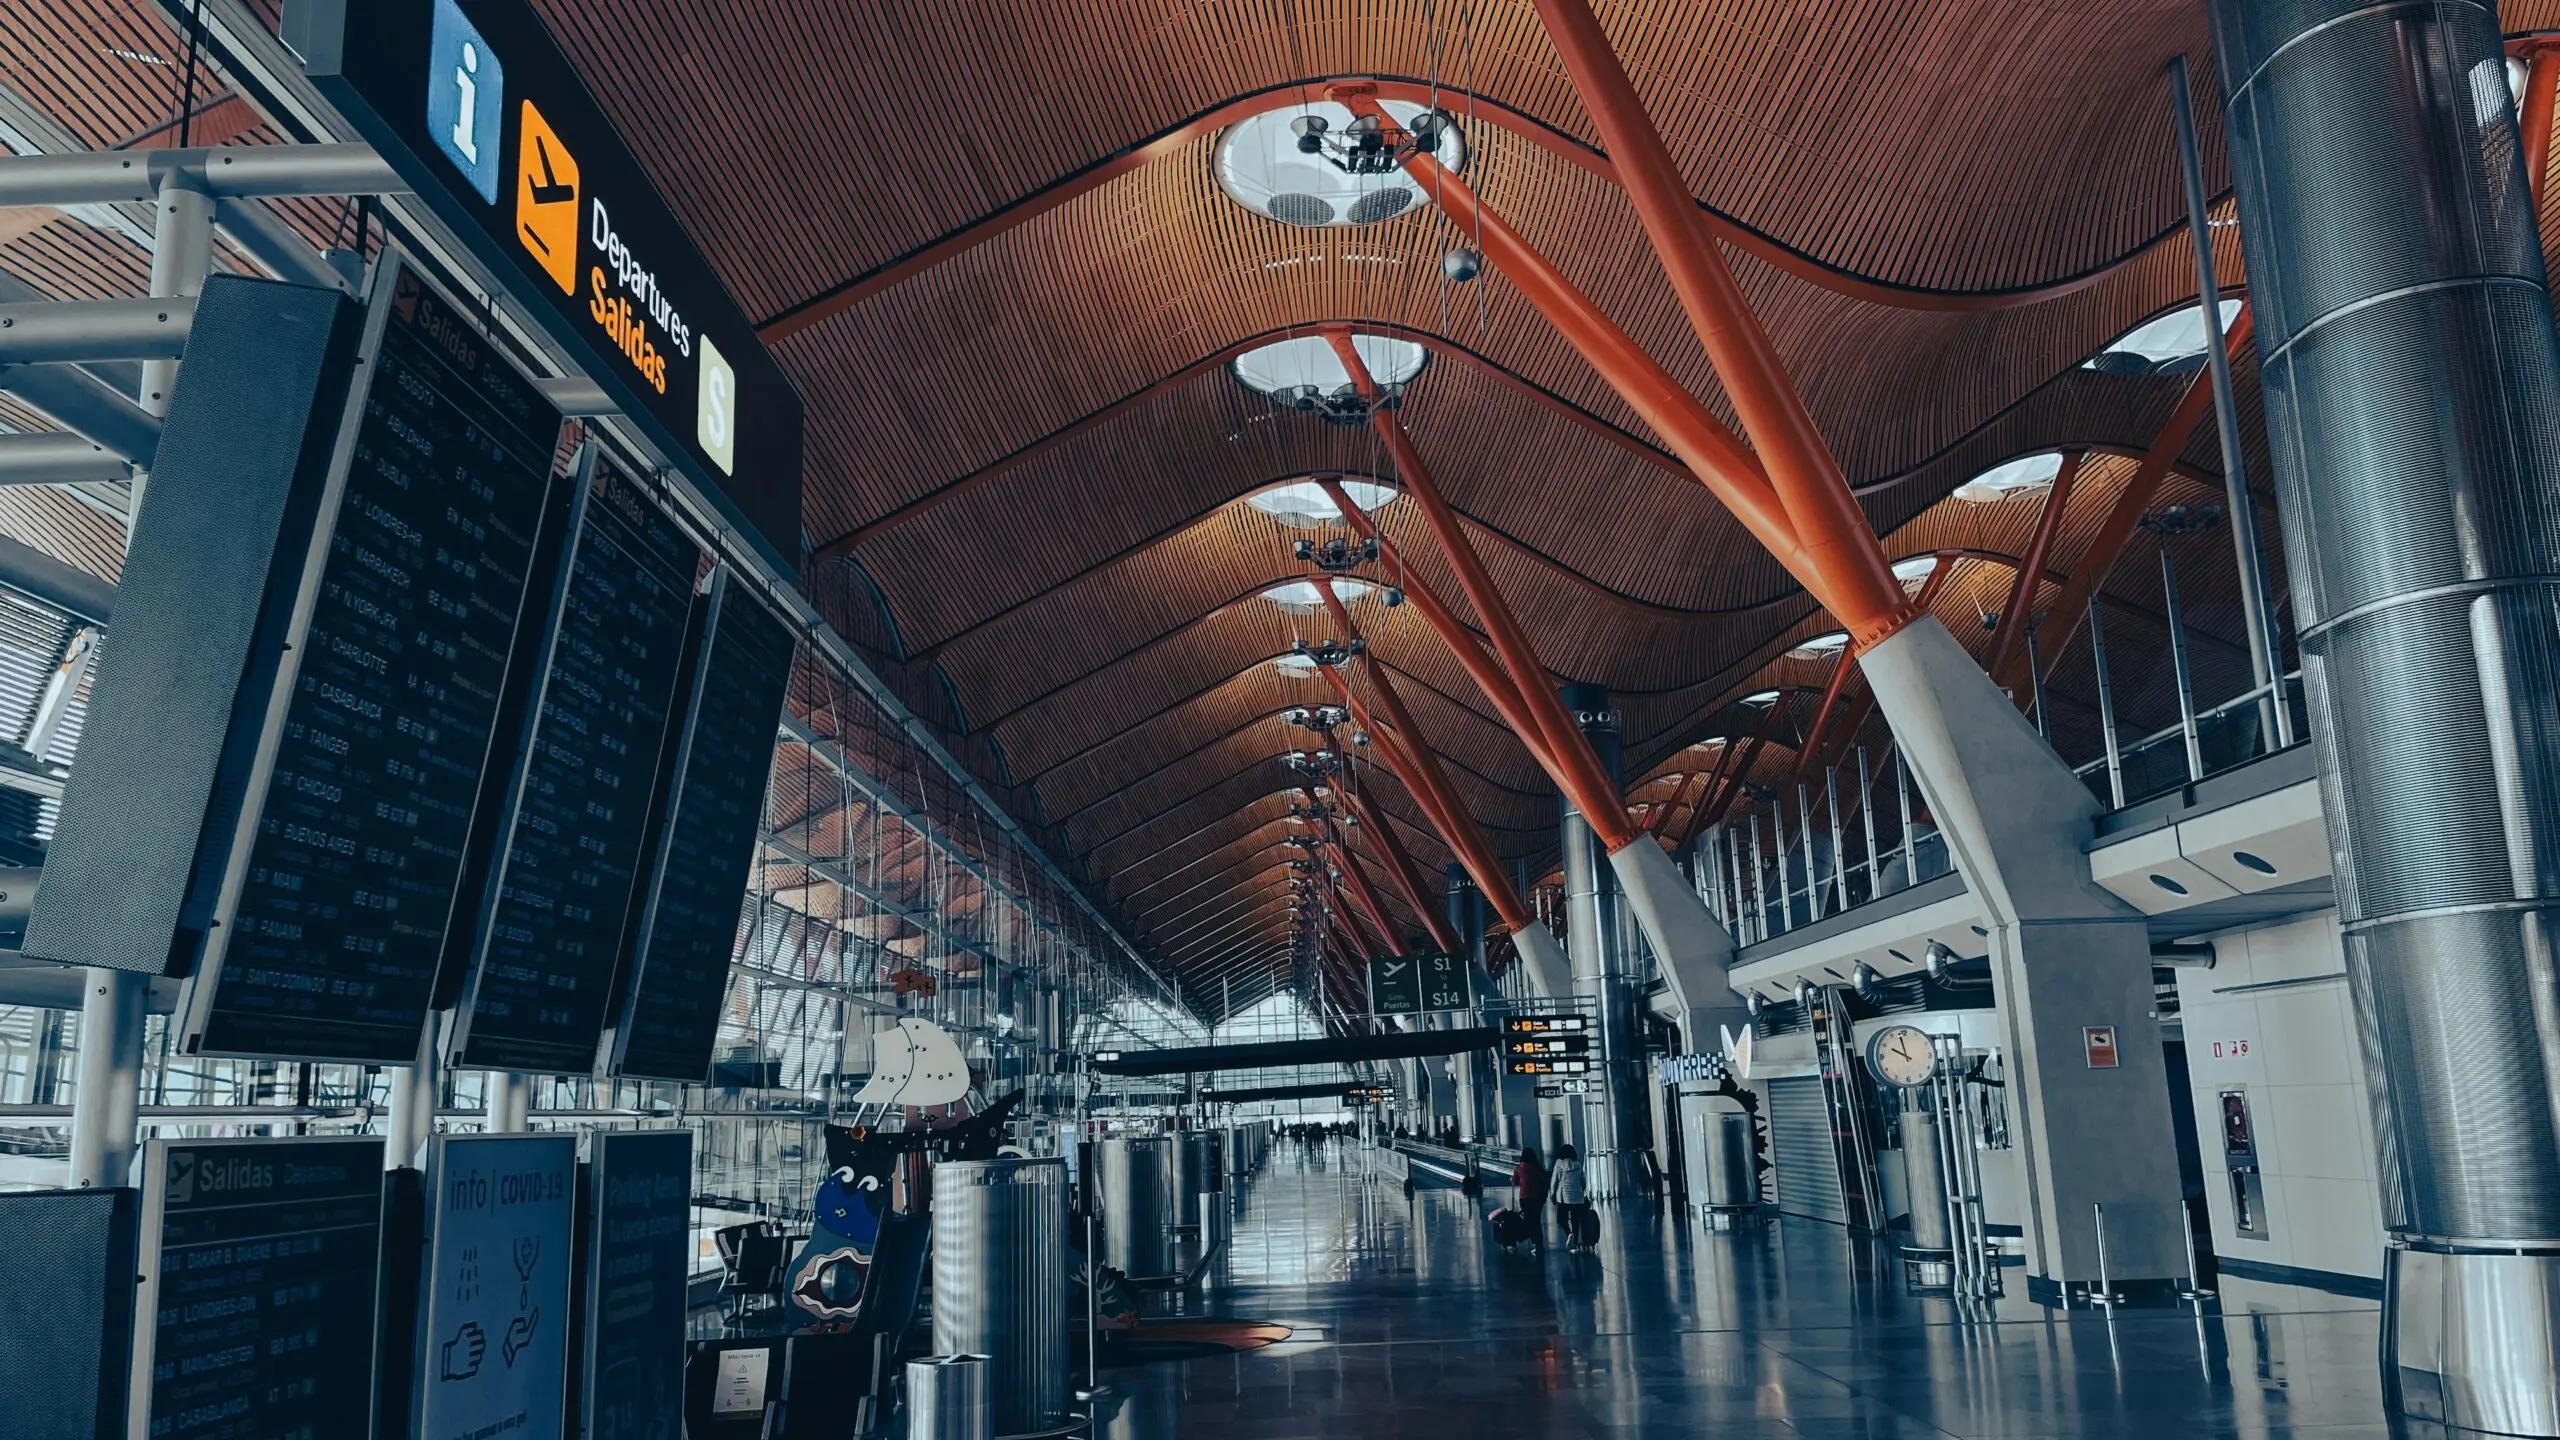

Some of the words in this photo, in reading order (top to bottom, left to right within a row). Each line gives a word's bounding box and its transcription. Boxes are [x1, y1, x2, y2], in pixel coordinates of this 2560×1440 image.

[592, 196, 691, 358] Departures
[418, 297, 478, 373] Salidas
[589, 266, 667, 395] Salidas
[706, 366, 727, 449] S
[607, 475, 645, 527] Salidas
[332, 636, 387, 675] CHARLOTTE
[320, 683, 382, 721] CASABLANCA
[309, 730, 349, 757] TANGER
[297, 777, 342, 804] CHICAGO
[284, 823, 326, 848] BUENOS
[328, 836, 355, 856] AIRES
[259, 920, 303, 942] PANAMA
[246, 969, 280, 987] SANTO
[1433, 957, 1453, 971] S1
[1383, 1001, 1410, 1009] Puertas
[1432, 992, 1460, 1006] S14
[199, 1158, 273, 1191] Salidas
[450, 1169, 487, 1211] info
[500, 1171, 563, 1205] COVID-19
[181, 1344, 254, 1375] MANCHESTER
[177, 1394, 250, 1430] CASABLANCA
